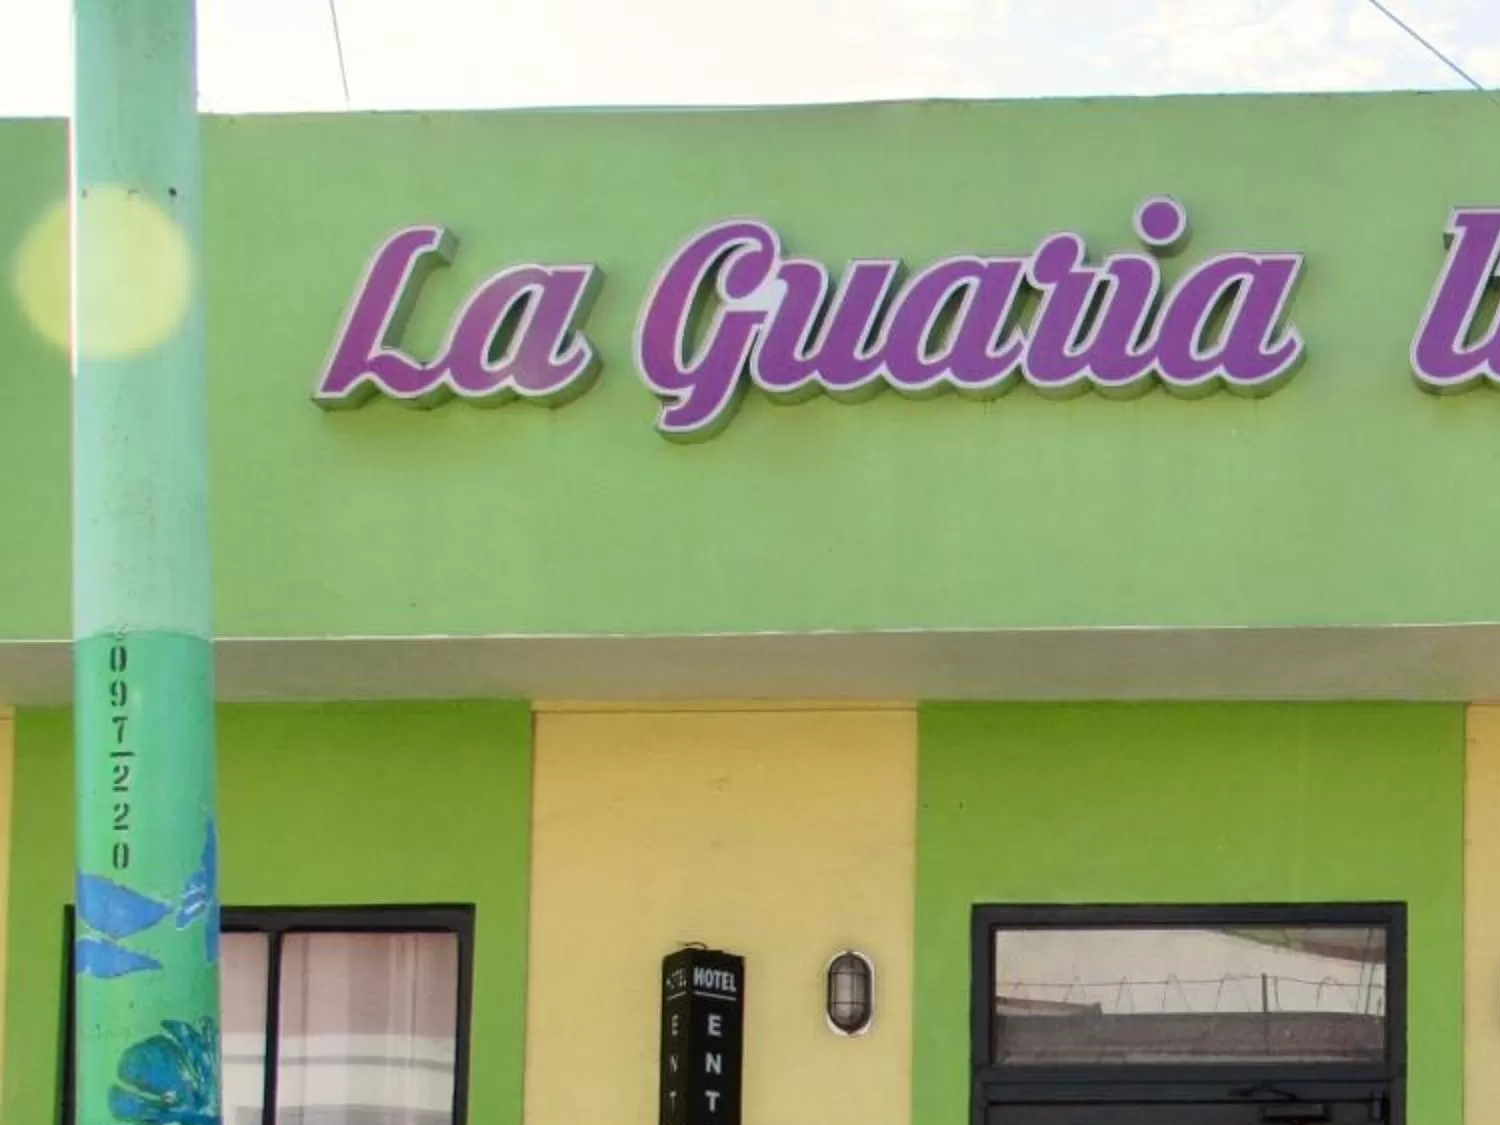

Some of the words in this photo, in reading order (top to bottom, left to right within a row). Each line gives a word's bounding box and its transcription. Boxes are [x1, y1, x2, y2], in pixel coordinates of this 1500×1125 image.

[313, 225, 602, 408] La
[634, 194, 1305, 441] Guaria
[693, 966, 737, 992] HOTEL
